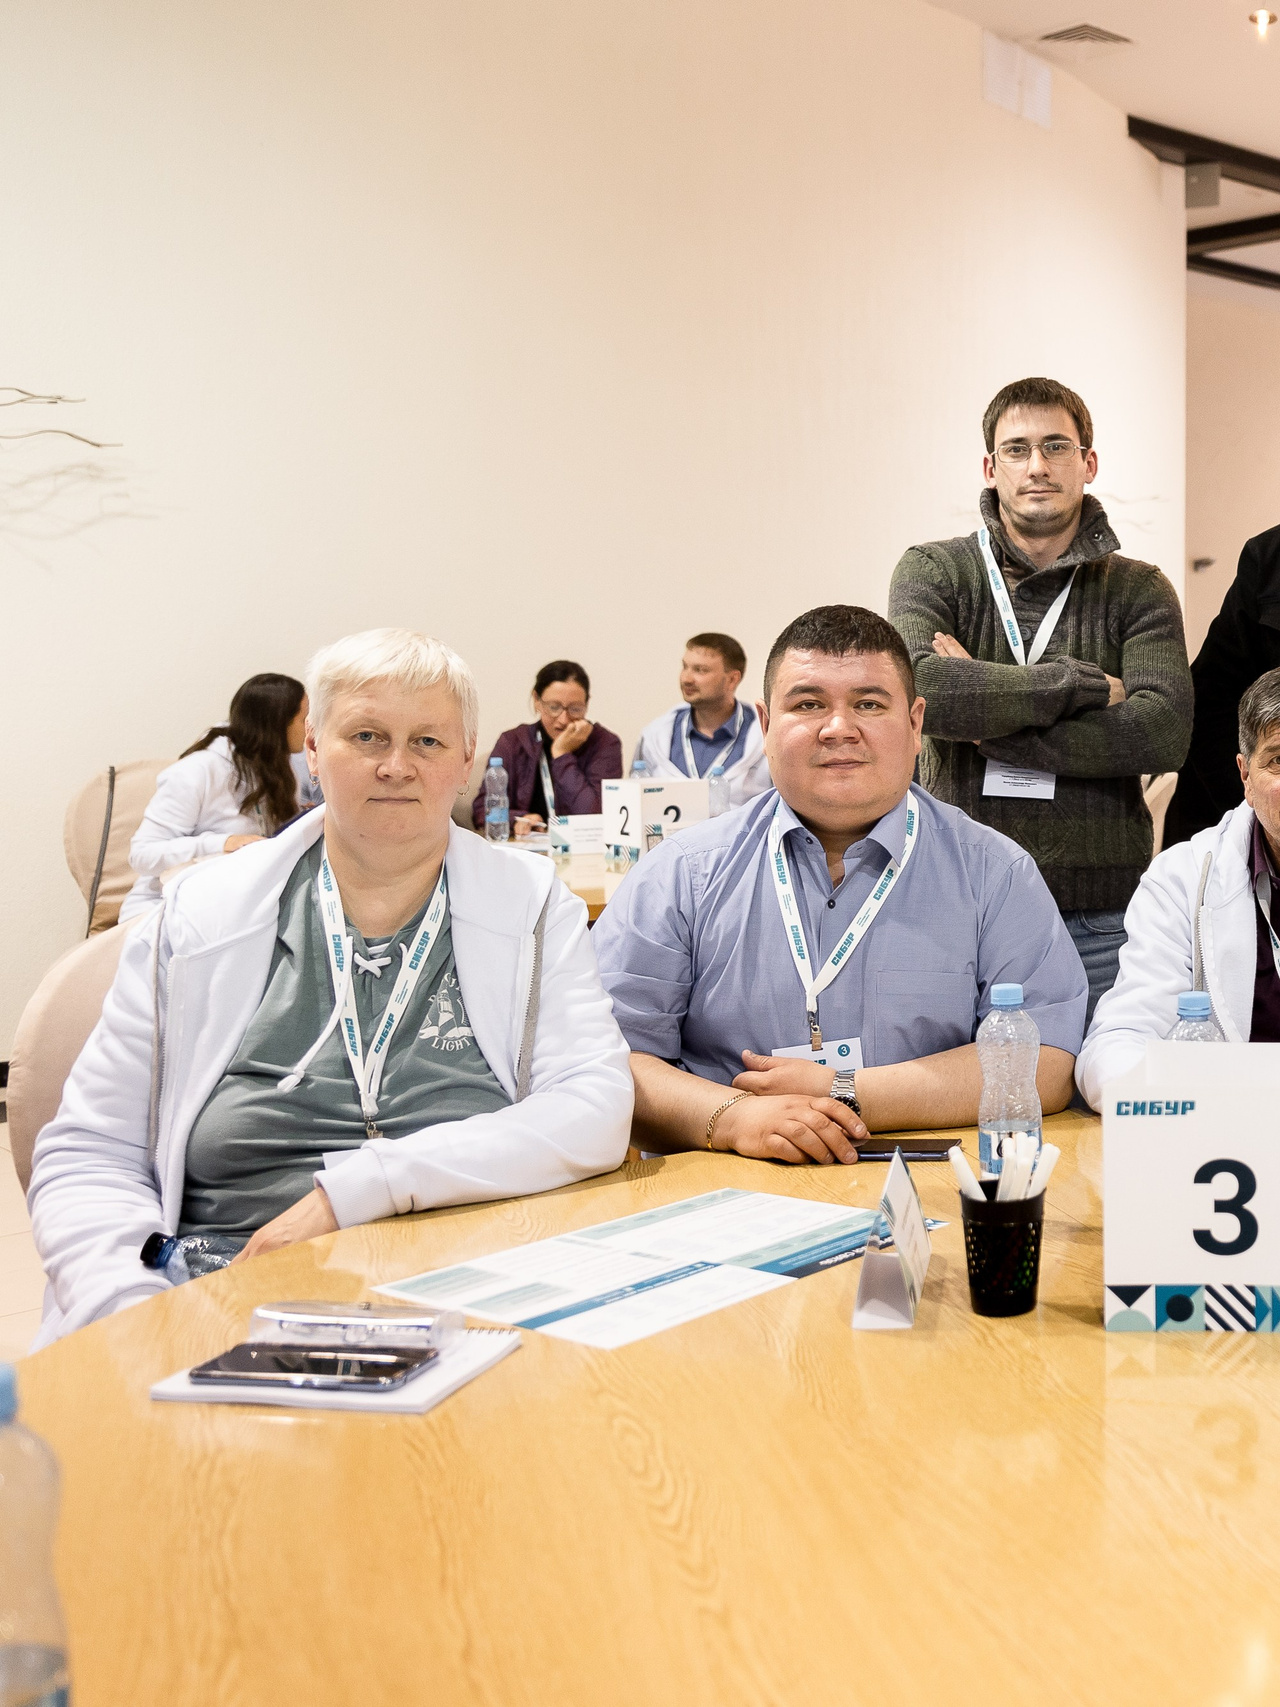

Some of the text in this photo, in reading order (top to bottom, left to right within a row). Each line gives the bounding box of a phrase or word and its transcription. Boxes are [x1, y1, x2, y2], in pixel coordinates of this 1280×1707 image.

[1006, 619, 1019, 647] СИБУР
[619, 805, 630, 837] 2
[906, 809, 915, 837] СИБУР
[322, 858, 333, 892] СИБУР
[873, 868, 895, 901] СИБУР
[332, 934, 344, 972] СИБУР
[408, 931, 430, 971] СИБУР
[790, 924, 806, 960] СИБУР
[831, 932, 855, 967] СИБУР
[344, 1017, 358, 1056] СИБУР
[374, 1013, 395, 1055] СИБУР
[431, 1037, 471, 1051] LIGHT
[841, 1046, 848, 1055] 3
[1116, 1100, 1196, 1117] СИБУР
[1192, 1158, 1259, 1256] 3
